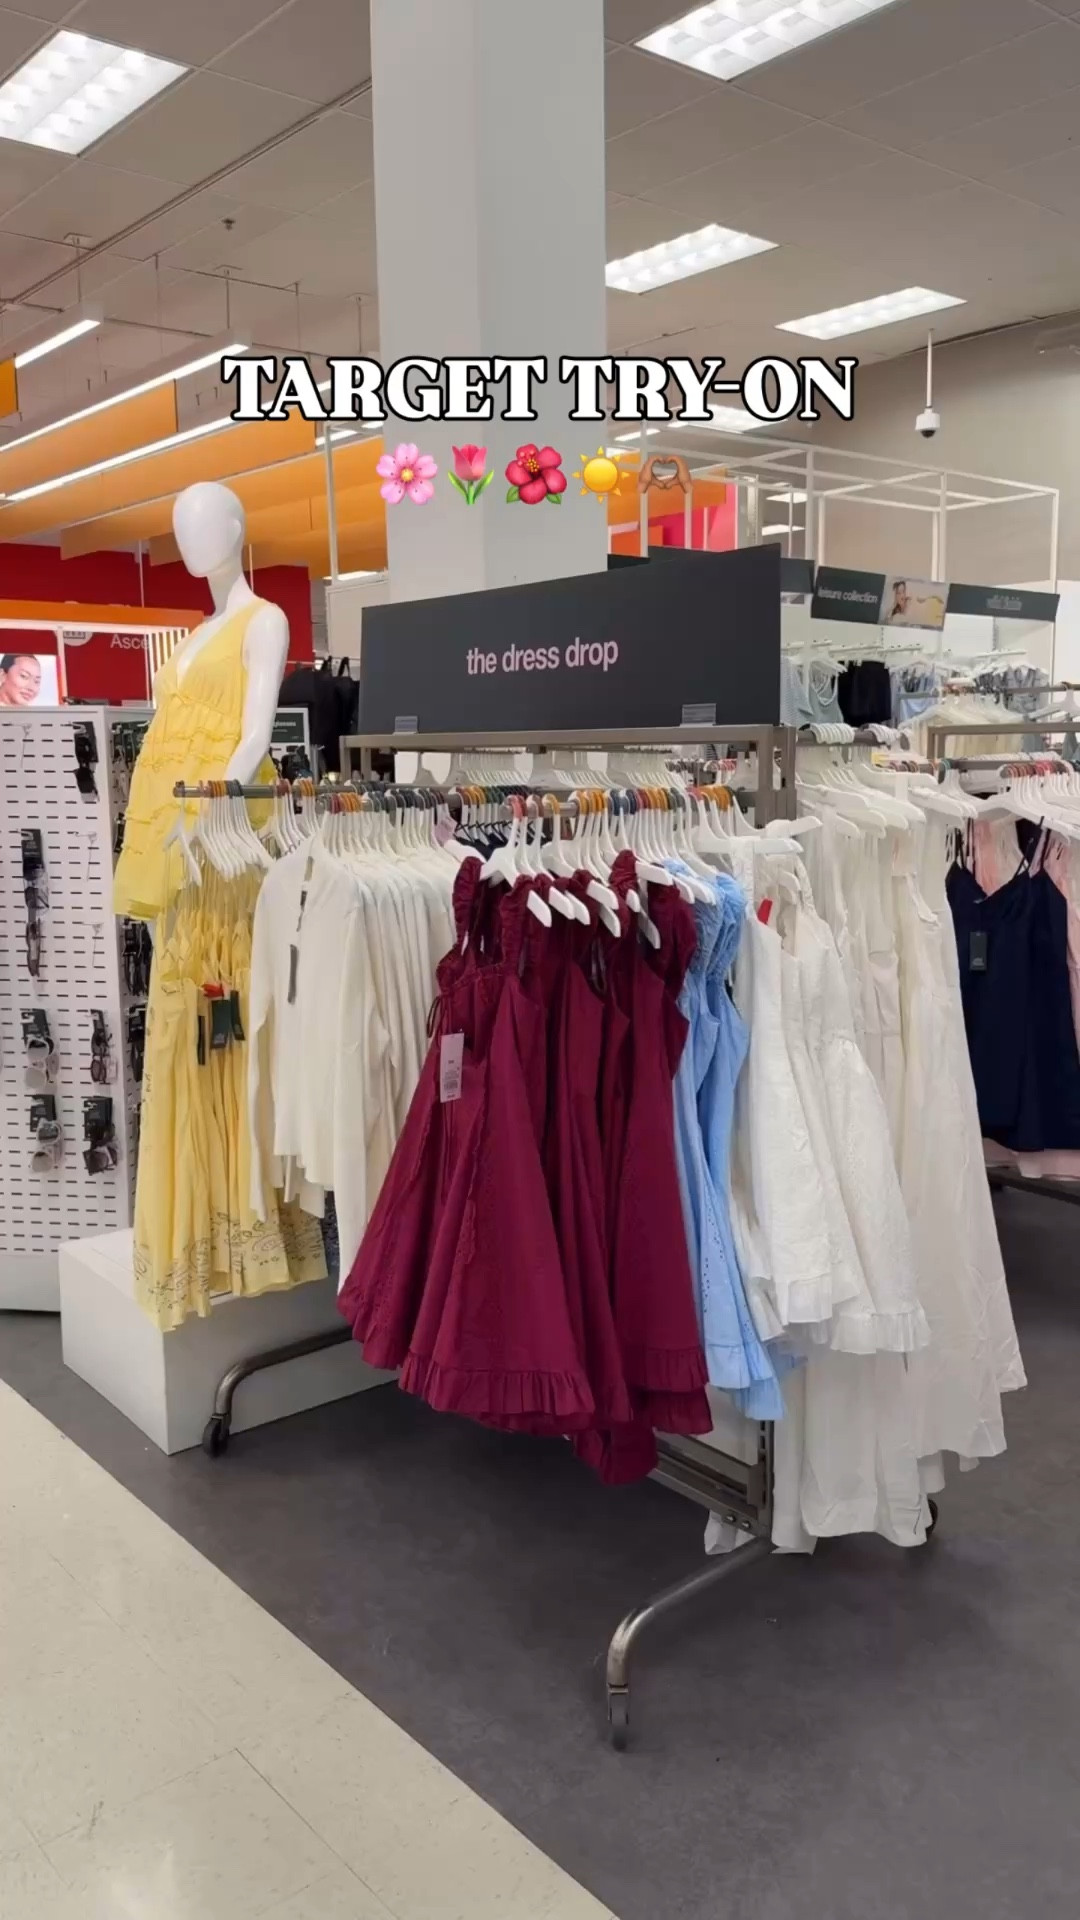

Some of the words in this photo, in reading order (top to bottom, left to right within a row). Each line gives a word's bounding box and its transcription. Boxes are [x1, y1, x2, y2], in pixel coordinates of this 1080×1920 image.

[843, 590, 879, 604] collection
[466, 647, 498, 675] the
[502, 643, 560, 673] dress
[565, 637, 619, 672] drop
